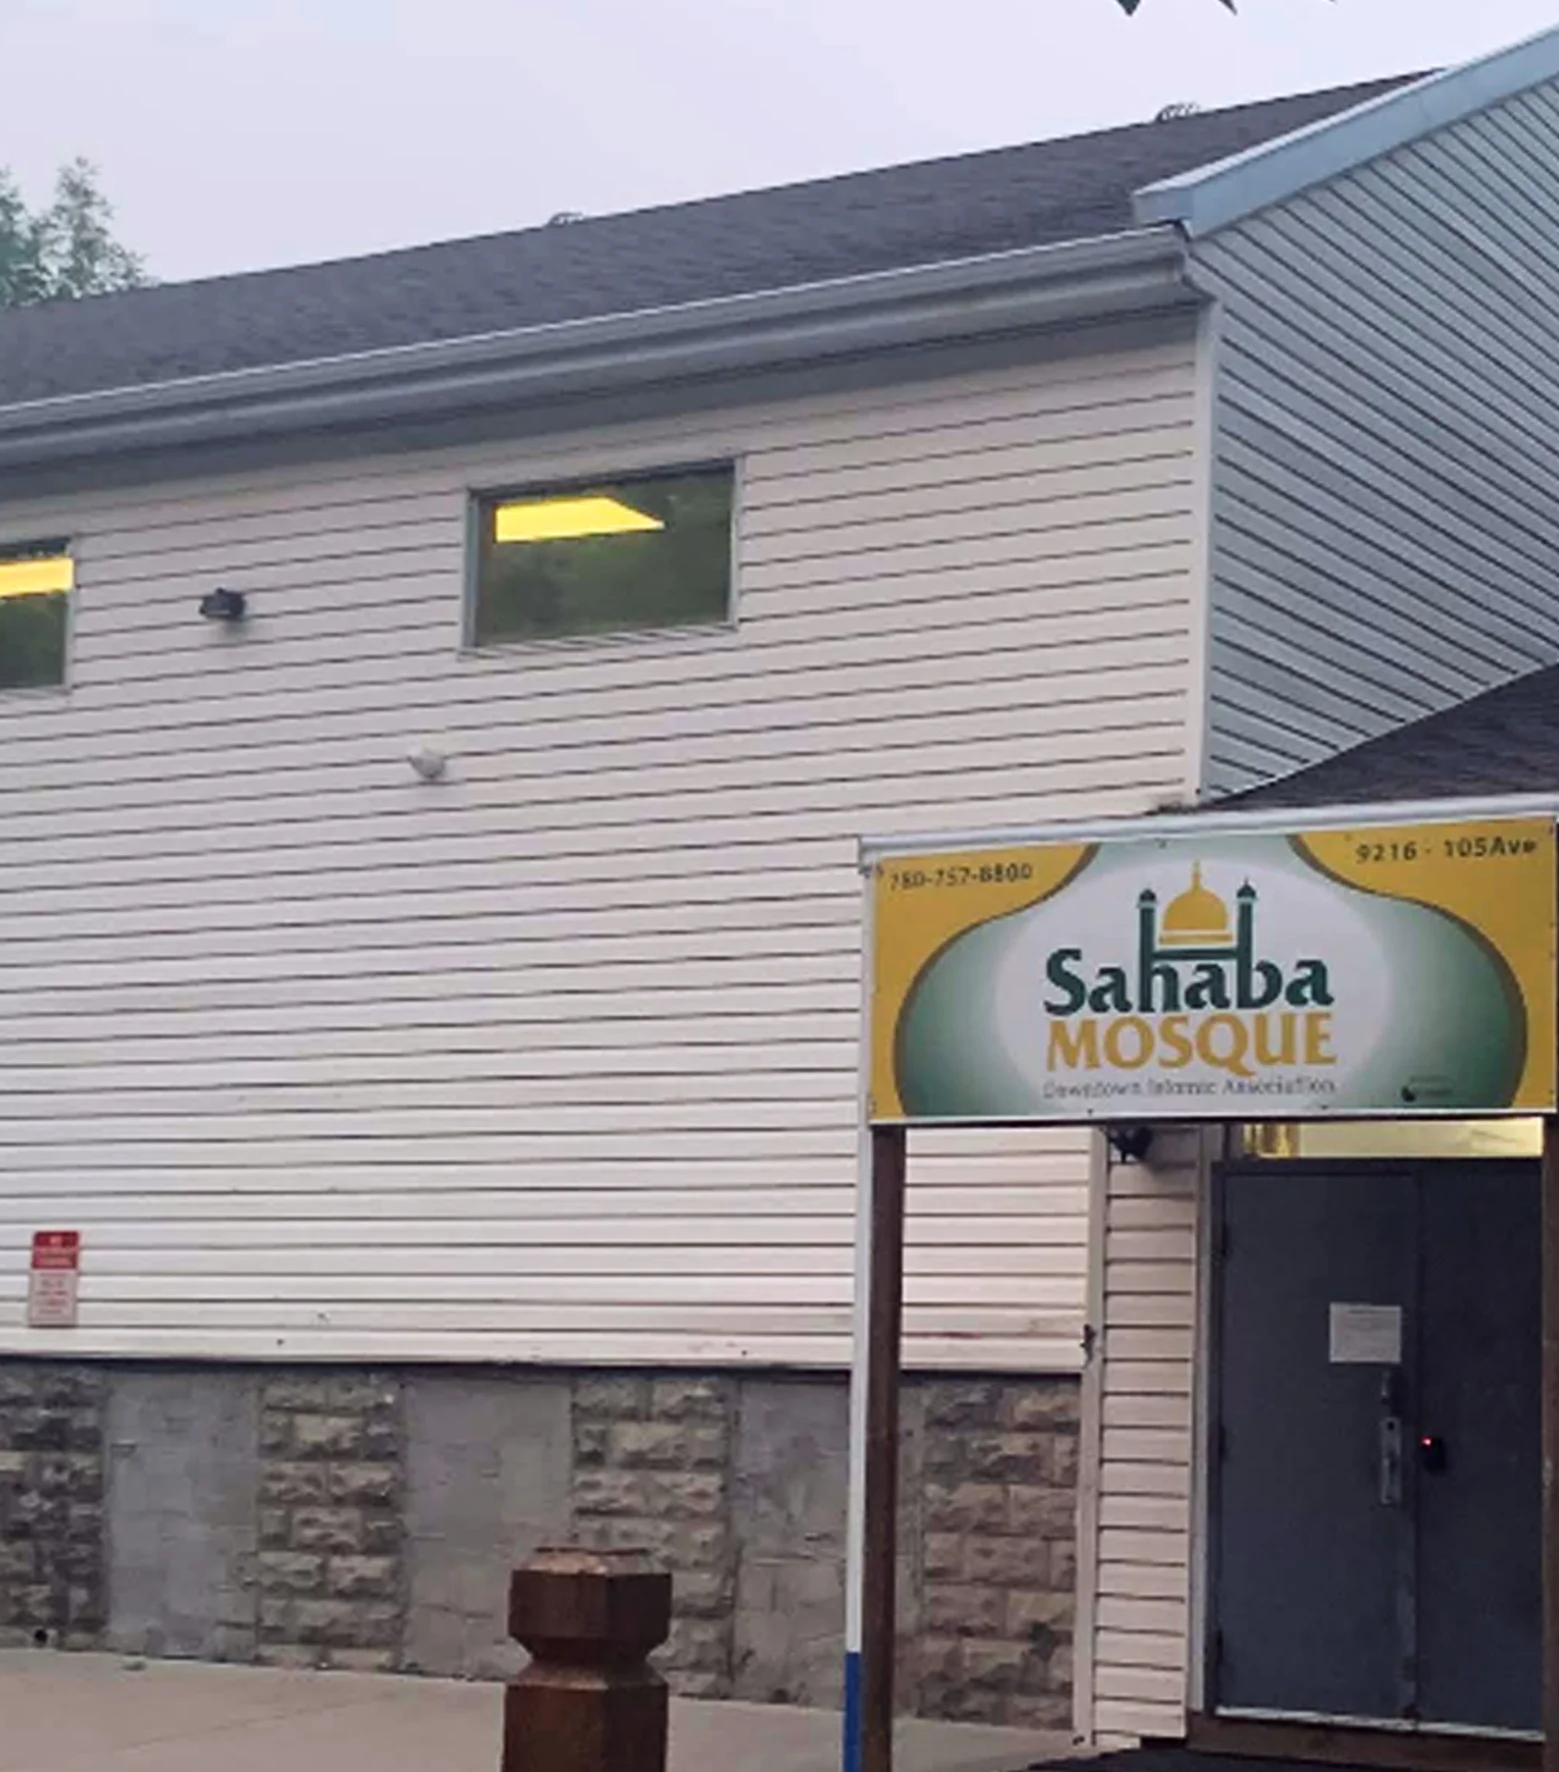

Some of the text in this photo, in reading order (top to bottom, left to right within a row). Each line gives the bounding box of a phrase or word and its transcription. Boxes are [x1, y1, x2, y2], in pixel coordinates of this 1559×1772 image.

[1355, 842, 1417, 864] 9216
[1043, 906, 1335, 1016] Sahaba
[1046, 1012, 1337, 1077] MOSQUE
[1043, 1074, 1337, 1099] Downtown Islamic Association
